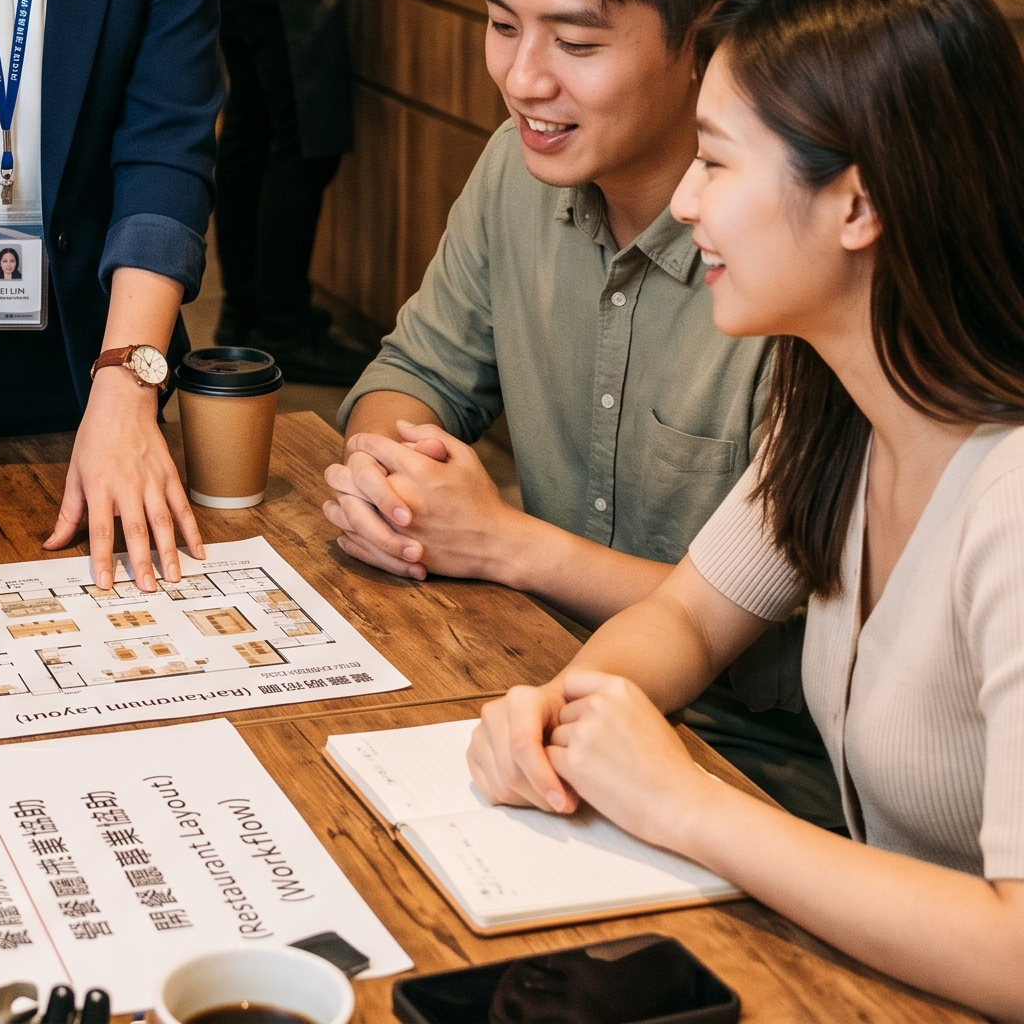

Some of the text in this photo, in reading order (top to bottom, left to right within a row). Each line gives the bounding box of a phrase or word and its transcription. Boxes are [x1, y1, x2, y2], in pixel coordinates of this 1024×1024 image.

[14, 704, 103, 725] Layout)
[142, 775, 274, 939] (Restaurant Layout)
[217, 799, 315, 902] (Workflow)
